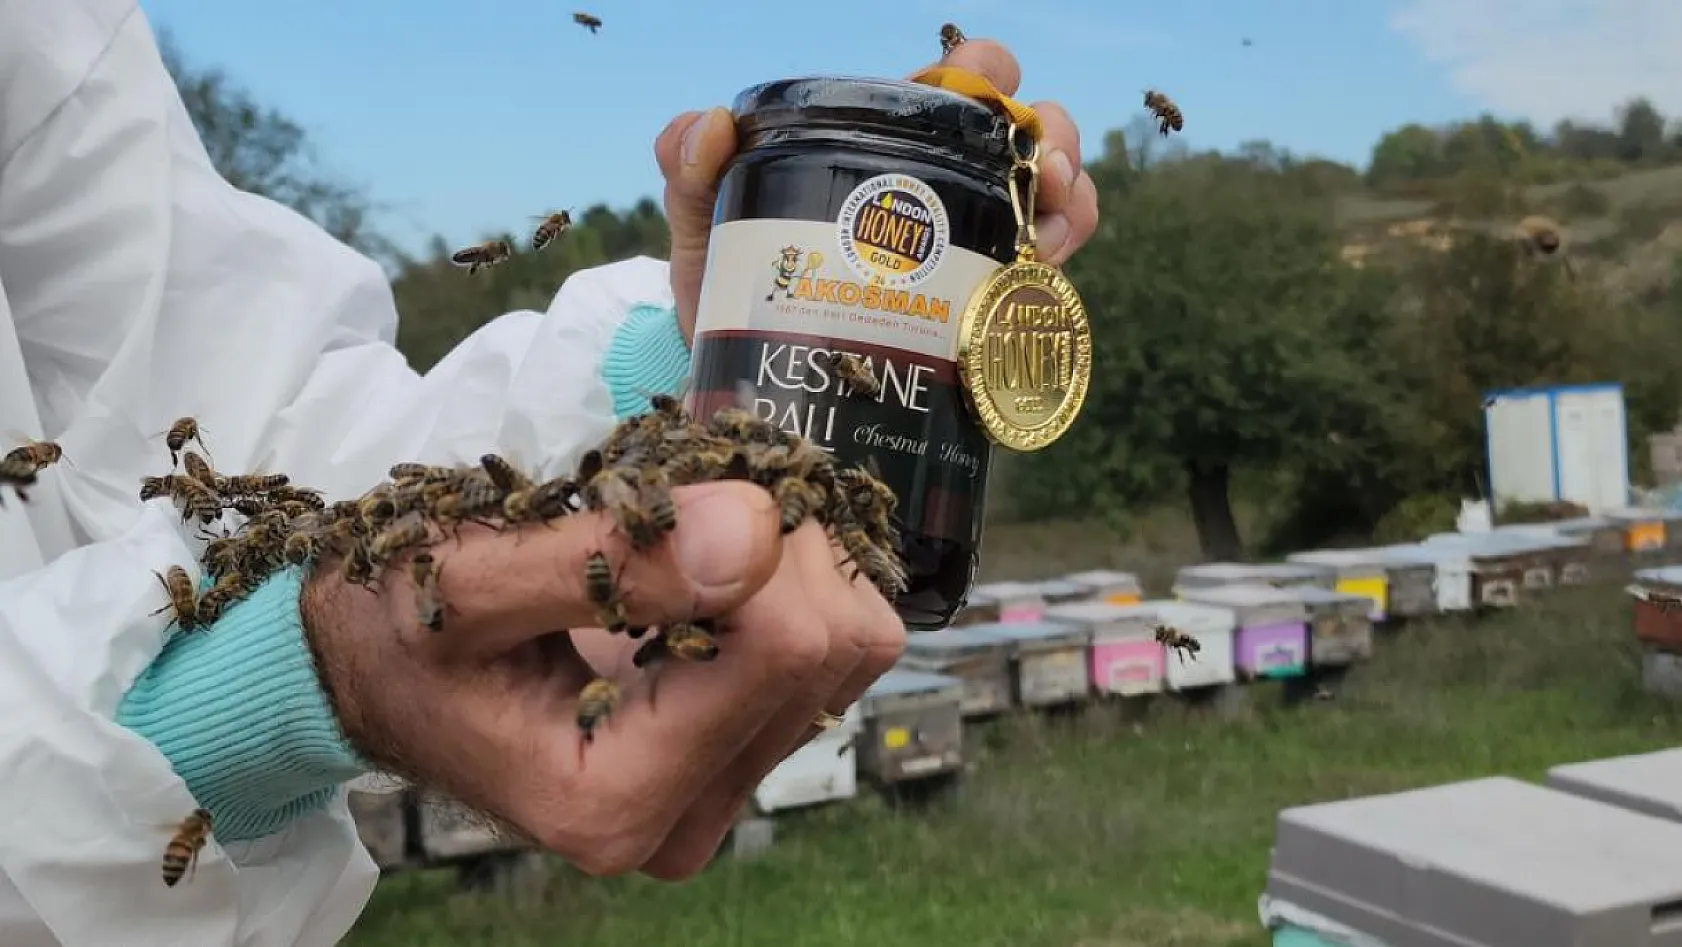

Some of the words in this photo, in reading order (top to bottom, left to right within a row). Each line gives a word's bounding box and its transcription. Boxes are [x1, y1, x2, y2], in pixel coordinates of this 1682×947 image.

[856, 205, 927, 256] HONEY
[870, 251, 901, 270] GOLD
[987, 332, 1060, 391] HONEY
[854, 423, 929, 456] Chestnut
[940, 441, 979, 479] Honey
